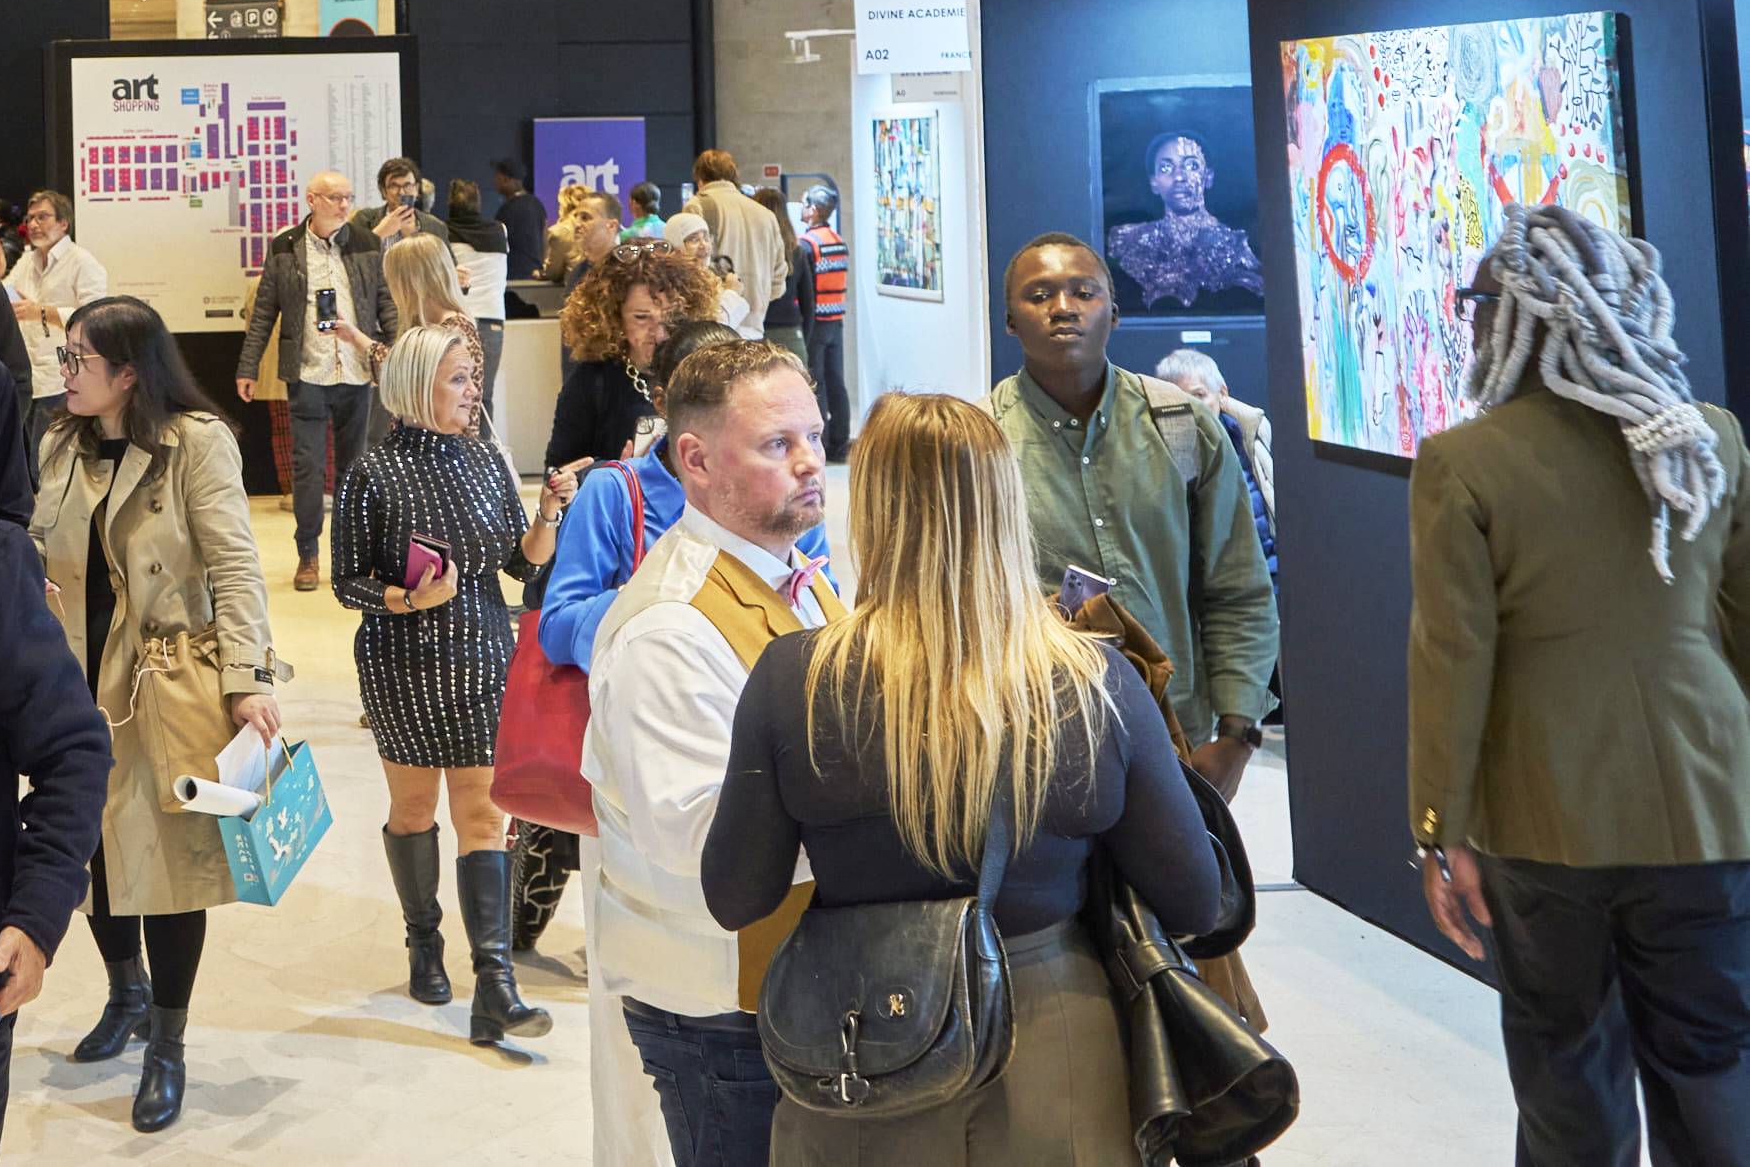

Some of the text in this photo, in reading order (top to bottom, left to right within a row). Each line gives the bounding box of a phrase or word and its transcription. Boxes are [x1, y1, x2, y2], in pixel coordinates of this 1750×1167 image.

[868, 7, 965, 20] DIVINE ACADEMIE
[866, 49, 890, 61] A02
[940, 51, 972, 60] FRANCE
[112, 72, 159, 101] art
[113, 100, 160, 113] SHOPPING
[560, 156, 620, 195] art
